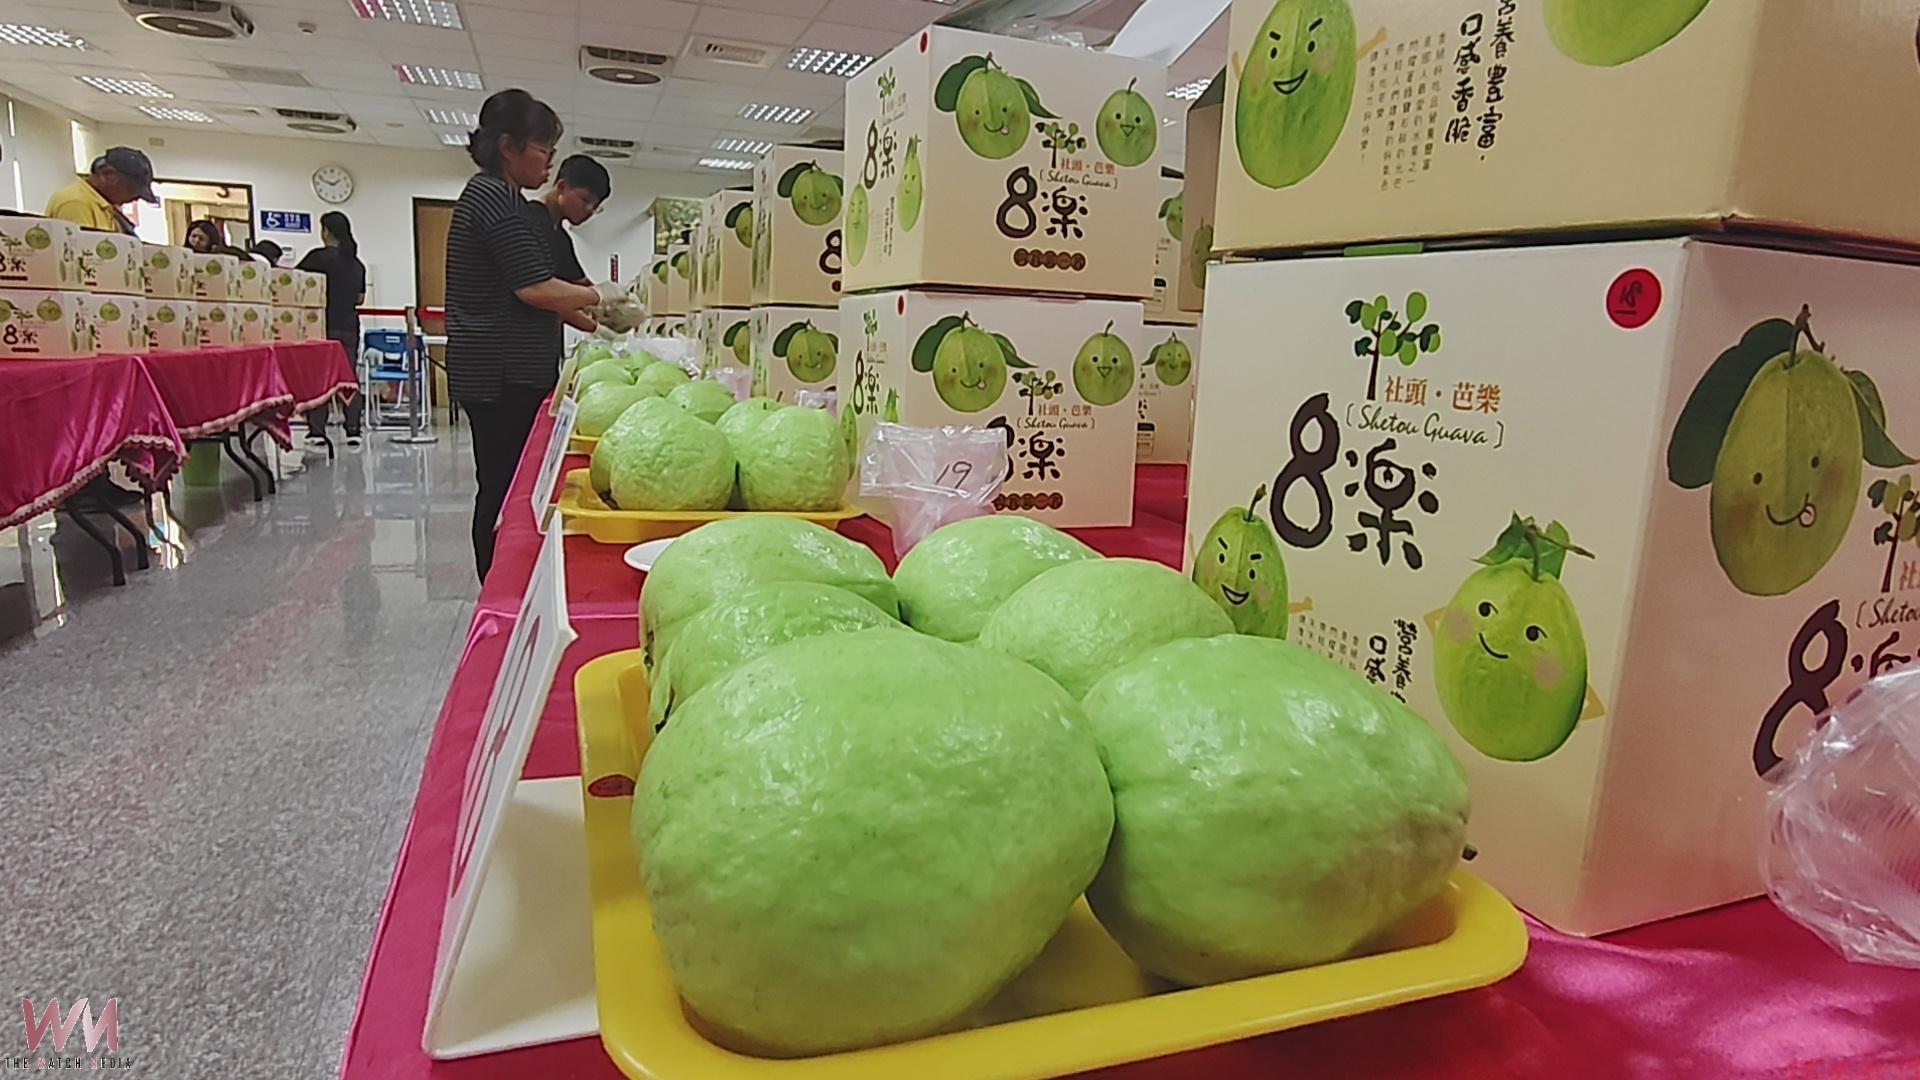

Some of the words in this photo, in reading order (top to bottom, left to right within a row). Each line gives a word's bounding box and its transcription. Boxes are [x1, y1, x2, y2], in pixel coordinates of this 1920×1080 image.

[1445, 13, 1483, 144] 口感香脆
[936, 461, 972, 489] 19
